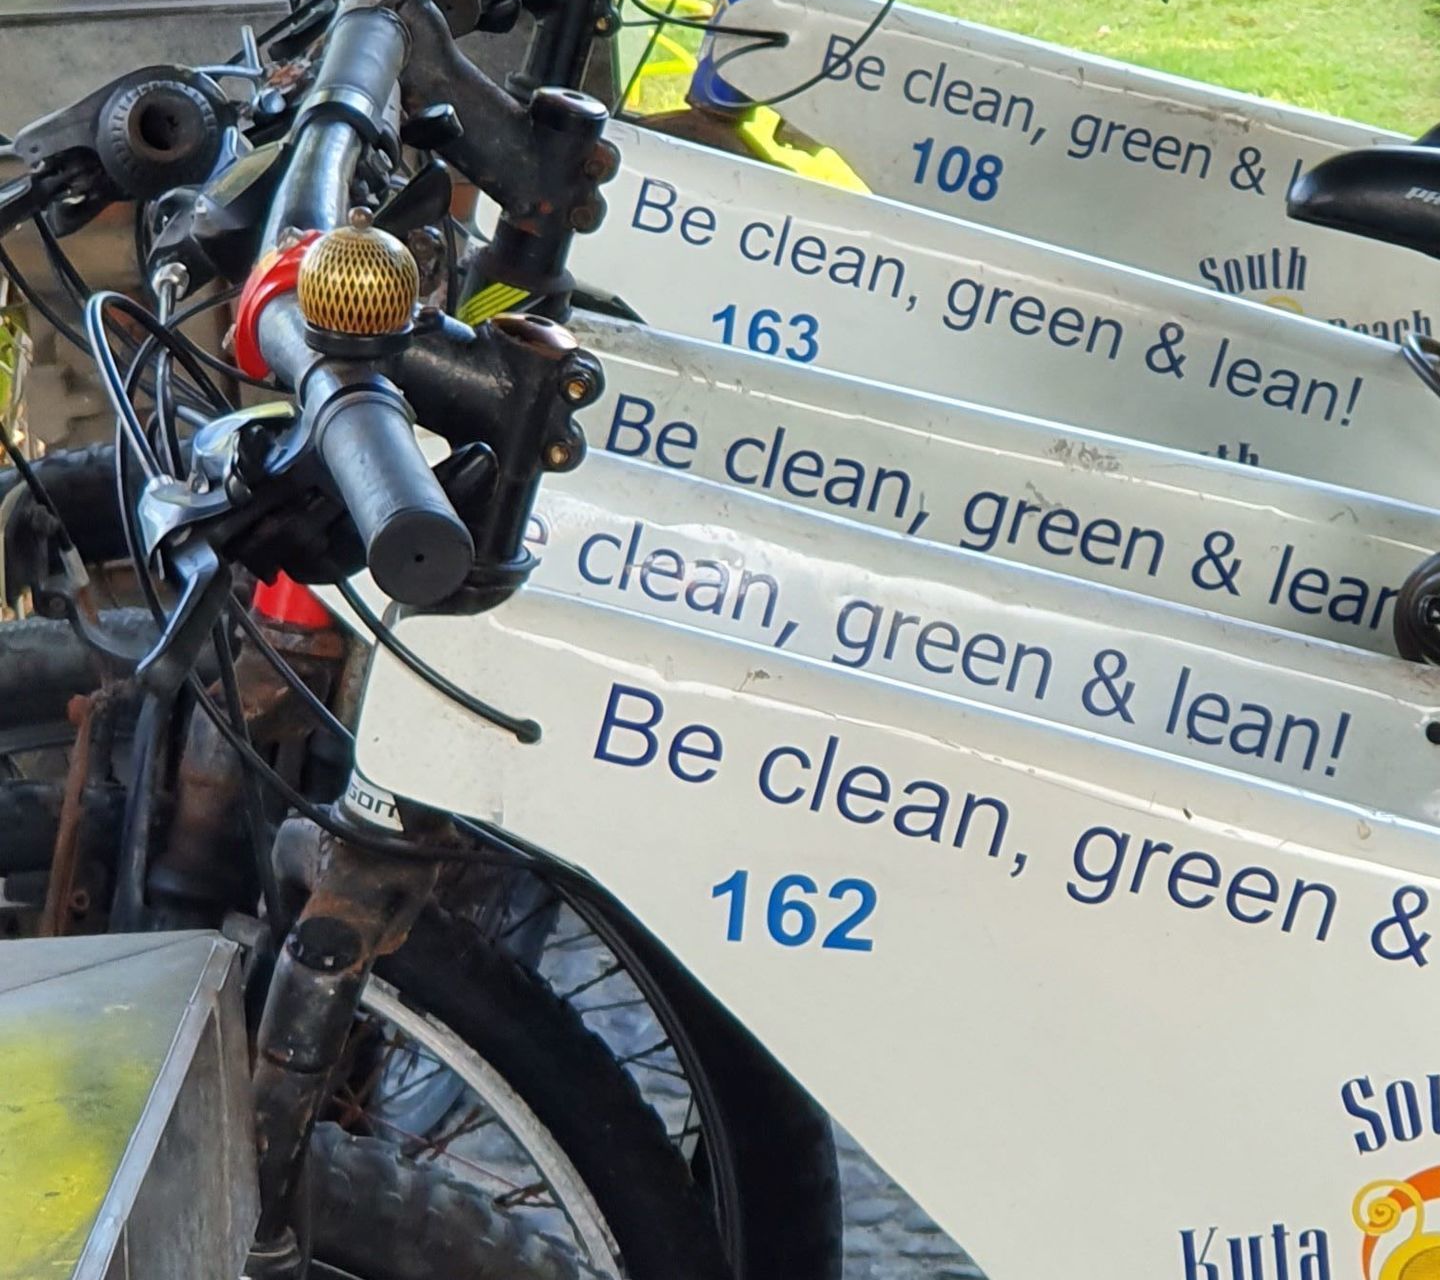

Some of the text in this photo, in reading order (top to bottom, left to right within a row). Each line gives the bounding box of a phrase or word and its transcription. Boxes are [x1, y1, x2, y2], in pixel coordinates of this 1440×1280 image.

[823, 33, 886, 92] Be
[904, 63, 1045, 145] clean,
[1068, 115, 1211, 178] green
[1230, 147, 1265, 195] &
[913, 138, 1003, 201] 108
[632, 178, 1362, 426] Be clean, green & lean!
[712, 305, 818, 362] 163
[1199, 246, 1307, 294] South
[605, 394, 697, 469] Be
[725, 427, 929, 535] clean,
[959, 492, 1164, 576] green
[1191, 531, 1241, 596] &
[578, 523, 798, 648] clean,
[832, 601, 1051, 699] green
[1082, 649, 1135, 722] &
[1166, 667, 1350, 777] lean!
[594, 683, 722, 783] Be
[759, 736, 1027, 877] clean,
[1067, 827, 1336, 941] green
[1371, 886, 1431, 967] &
[712, 870, 876, 951] 162
